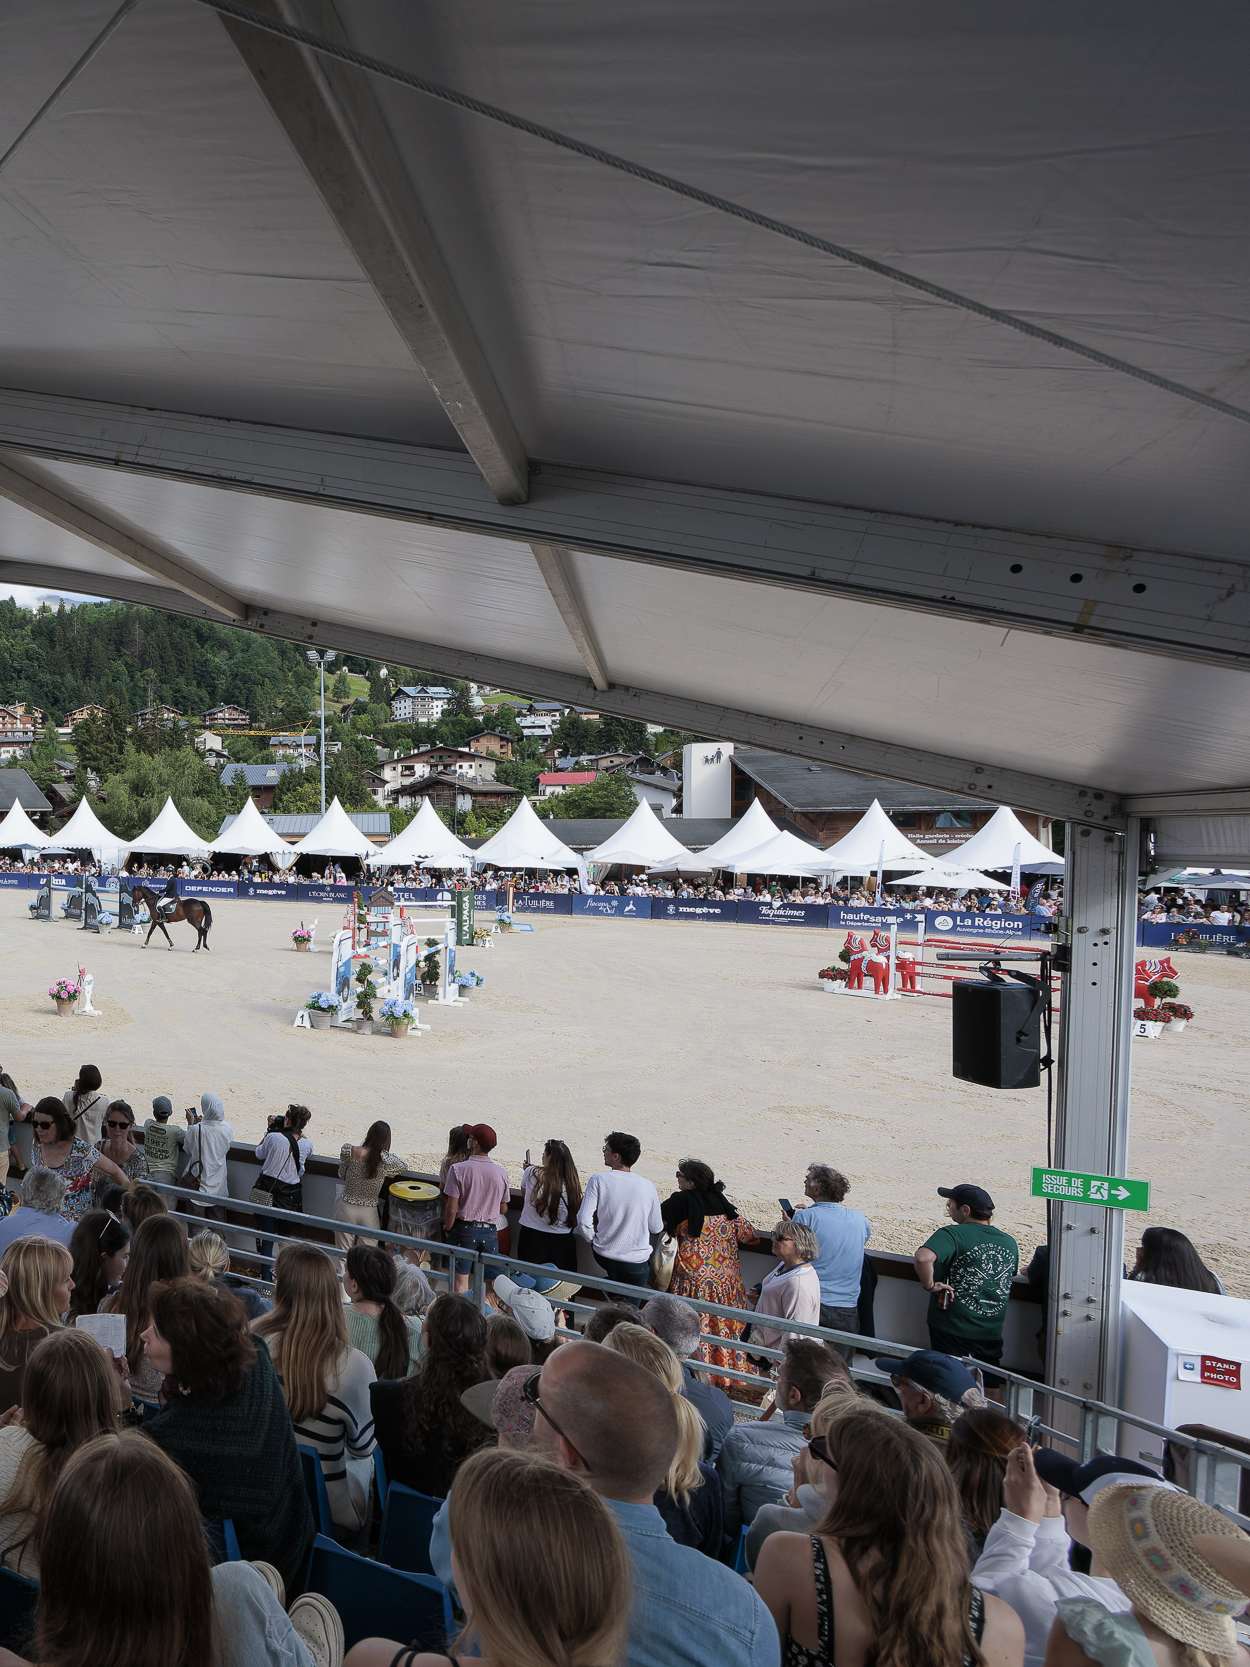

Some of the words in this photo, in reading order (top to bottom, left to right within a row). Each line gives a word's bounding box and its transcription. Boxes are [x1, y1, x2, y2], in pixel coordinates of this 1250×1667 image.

[185, 885, 234, 893] DEFENDER
[256, 888, 287, 896] megève
[678, 905, 722, 915] megève
[759, 905, 806, 918] Toquicimes
[462, 894, 470, 940] L'ALPAGA
[840, 911, 904, 924] hautesave
[956, 916, 972, 926] La
[975, 917, 1023, 930] Région
[956, 926, 1023, 936] Auvergne-Rhône-Alpes
[415, 983, 422, 992] 15
[300, 1013, 305, 1024] 1
[1139, 1023, 1147, 1034] 5
[1042, 1173, 1069, 1186] ISSUE
[1071, 1177, 1085, 1188] DE
[1041, 1184, 1084, 1198] SECOURS
[1204, 1360, 1237, 1371] STAND
[1204, 1371, 1238, 1384] PHOTO
